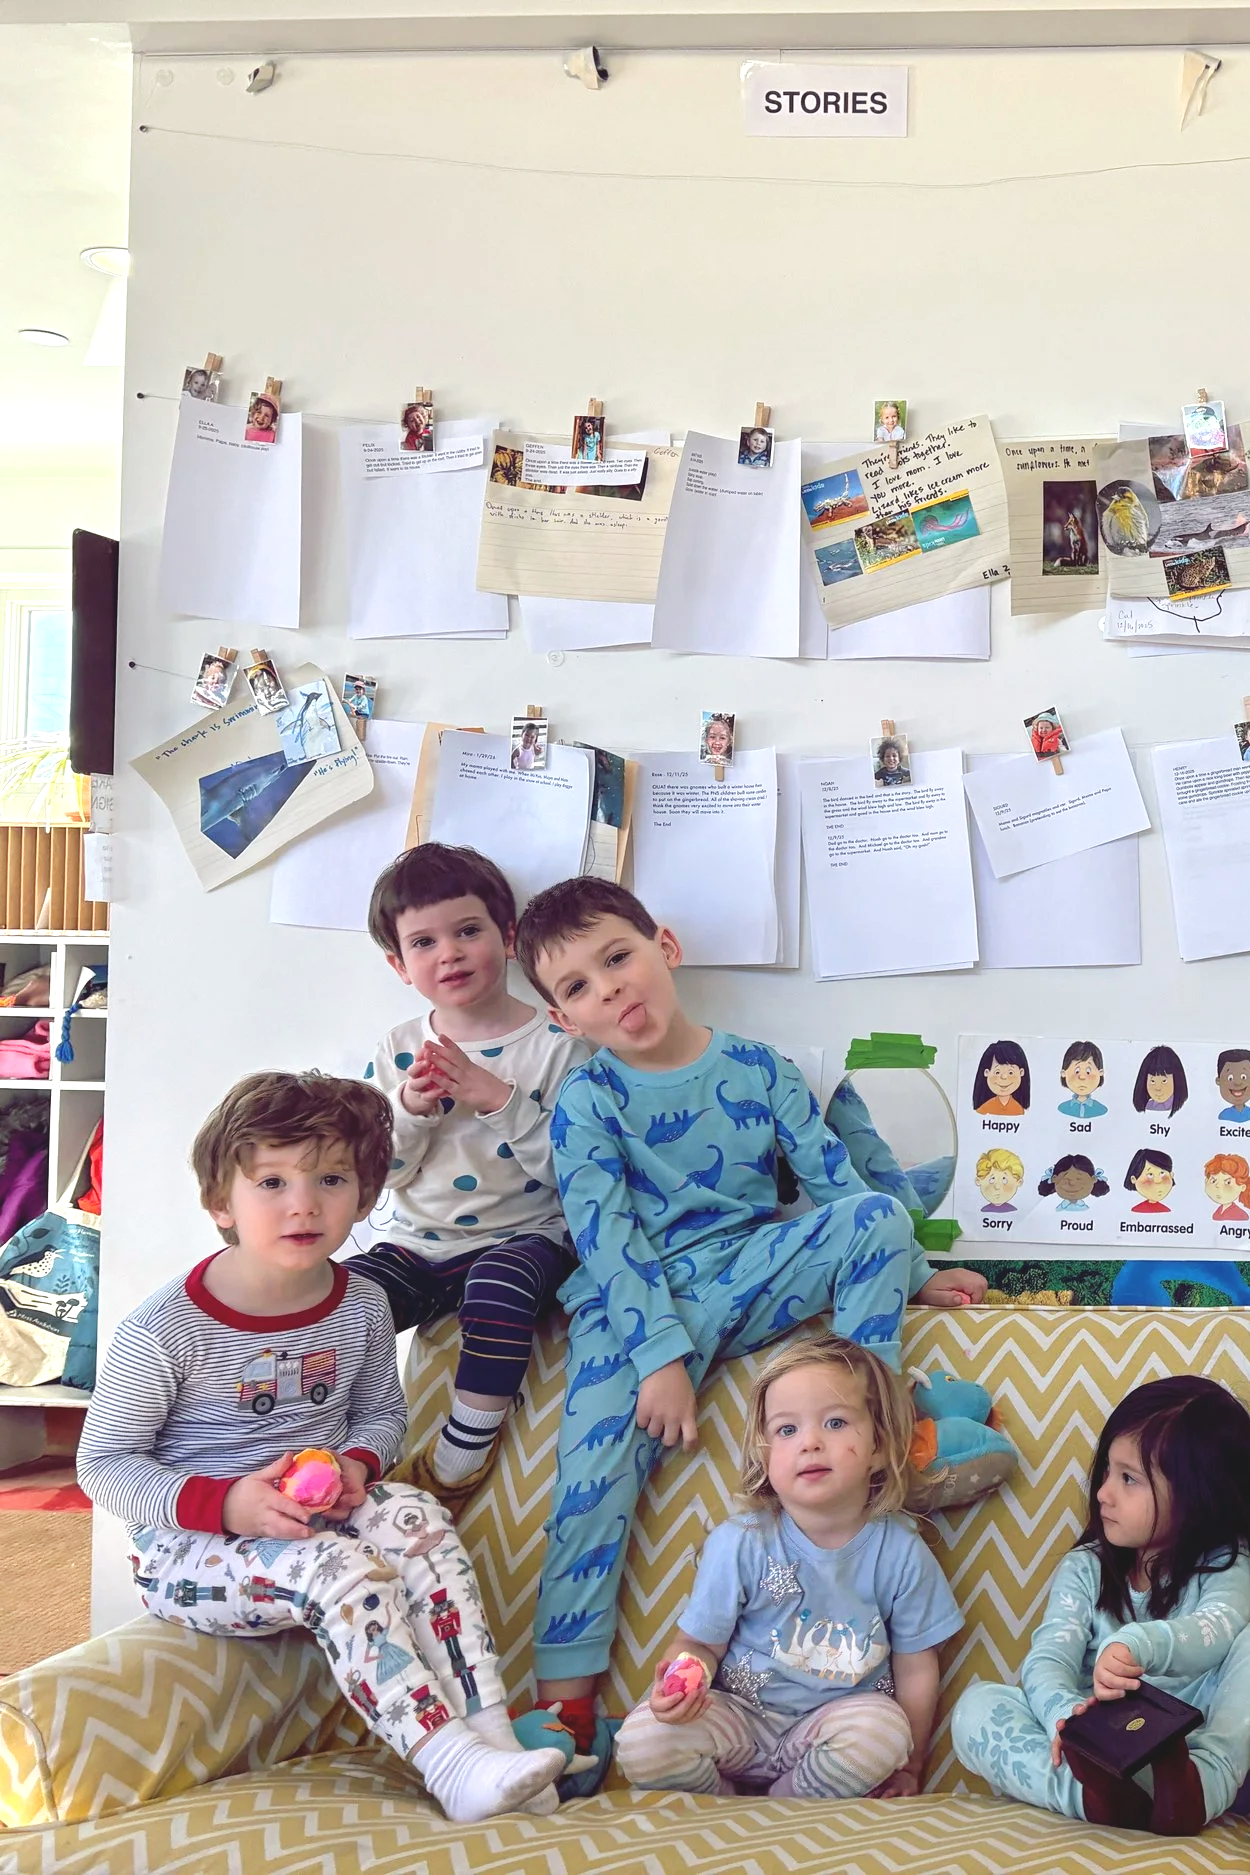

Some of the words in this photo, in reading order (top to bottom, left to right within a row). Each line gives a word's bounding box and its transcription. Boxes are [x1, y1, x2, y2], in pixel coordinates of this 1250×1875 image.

[764, 90, 888, 114] STORIES
[924, 433, 947, 443] They
[947, 424, 966, 436] like
[967, 420, 977, 428] to
[1005, 447, 1023, 456] Once
[1028, 447, 1045, 458] upon
[1060, 444, 1078, 454] time,
[864, 466, 884, 479] read
[912, 441, 951, 460] together.
[1016, 460, 1060, 471] sunflowers.
[885, 474, 901, 485] love
[906, 465, 931, 477] mom.
[945, 450, 963, 460] love
[890, 481, 915, 493] more.
[903, 486, 924, 500] likes
[966, 462, 990, 475] more
[897, 500, 912, 511] his
[913, 487, 947, 504] friends.
[982, 568, 1000, 579] Ella
[1118, 610, 1133, 619] Cal
[181, 730, 208, 747] shark
[982, 1120, 1020, 1134] Happy
[1069, 1122, 1092, 1133] Sad
[1150, 1124, 1170, 1137] Shy
[982, 1218, 1013, 1231] Sorry
[1060, 1220, 1094, 1231] Proud
[1120, 1222, 1194, 1234] Embarrassed
